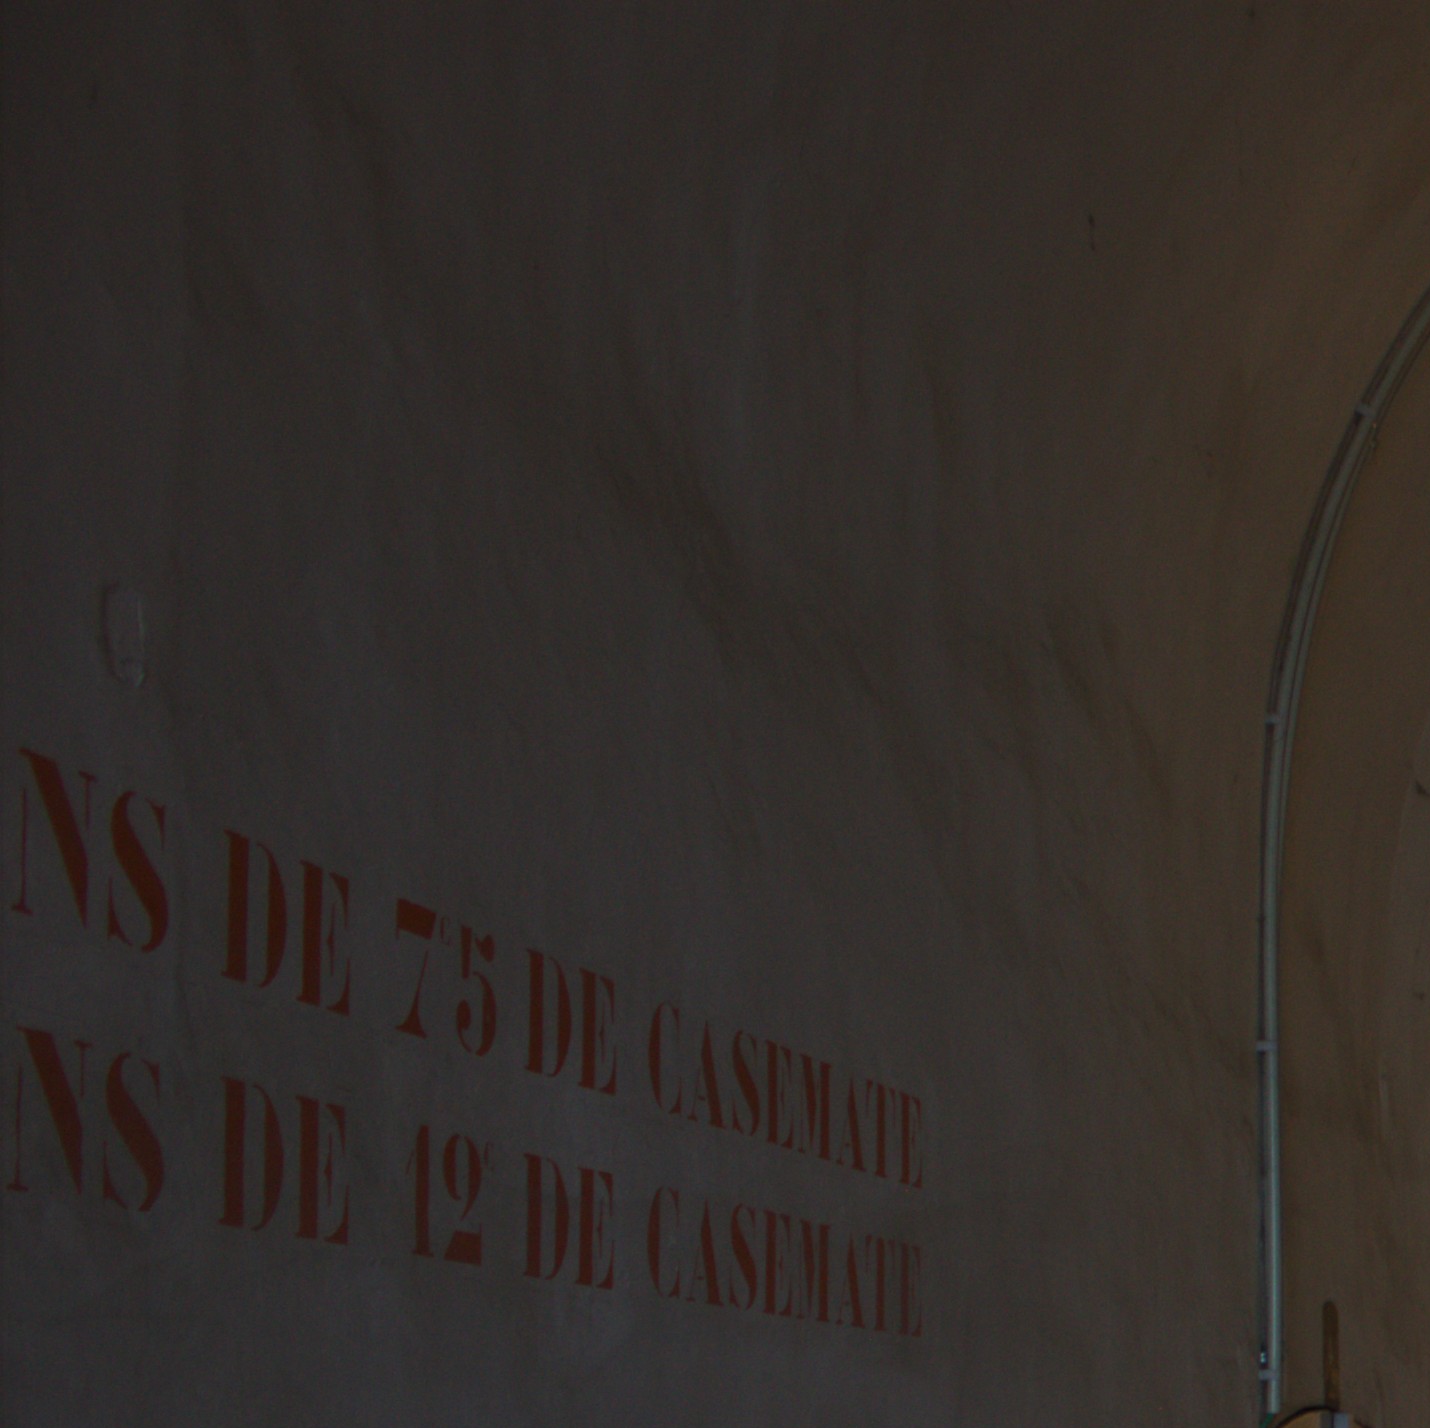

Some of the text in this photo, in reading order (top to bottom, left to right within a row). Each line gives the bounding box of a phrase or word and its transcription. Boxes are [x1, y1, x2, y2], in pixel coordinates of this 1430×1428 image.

[222, 829, 351, 1016] DE
[526, 949, 618, 1096] DE
[648, 1002, 924, 1190] CASEMATE
[218, 1076, 350, 1246] DE
[523, 1152, 615, 1290] DE
[647, 1186, 924, 1338] CASEMATE
